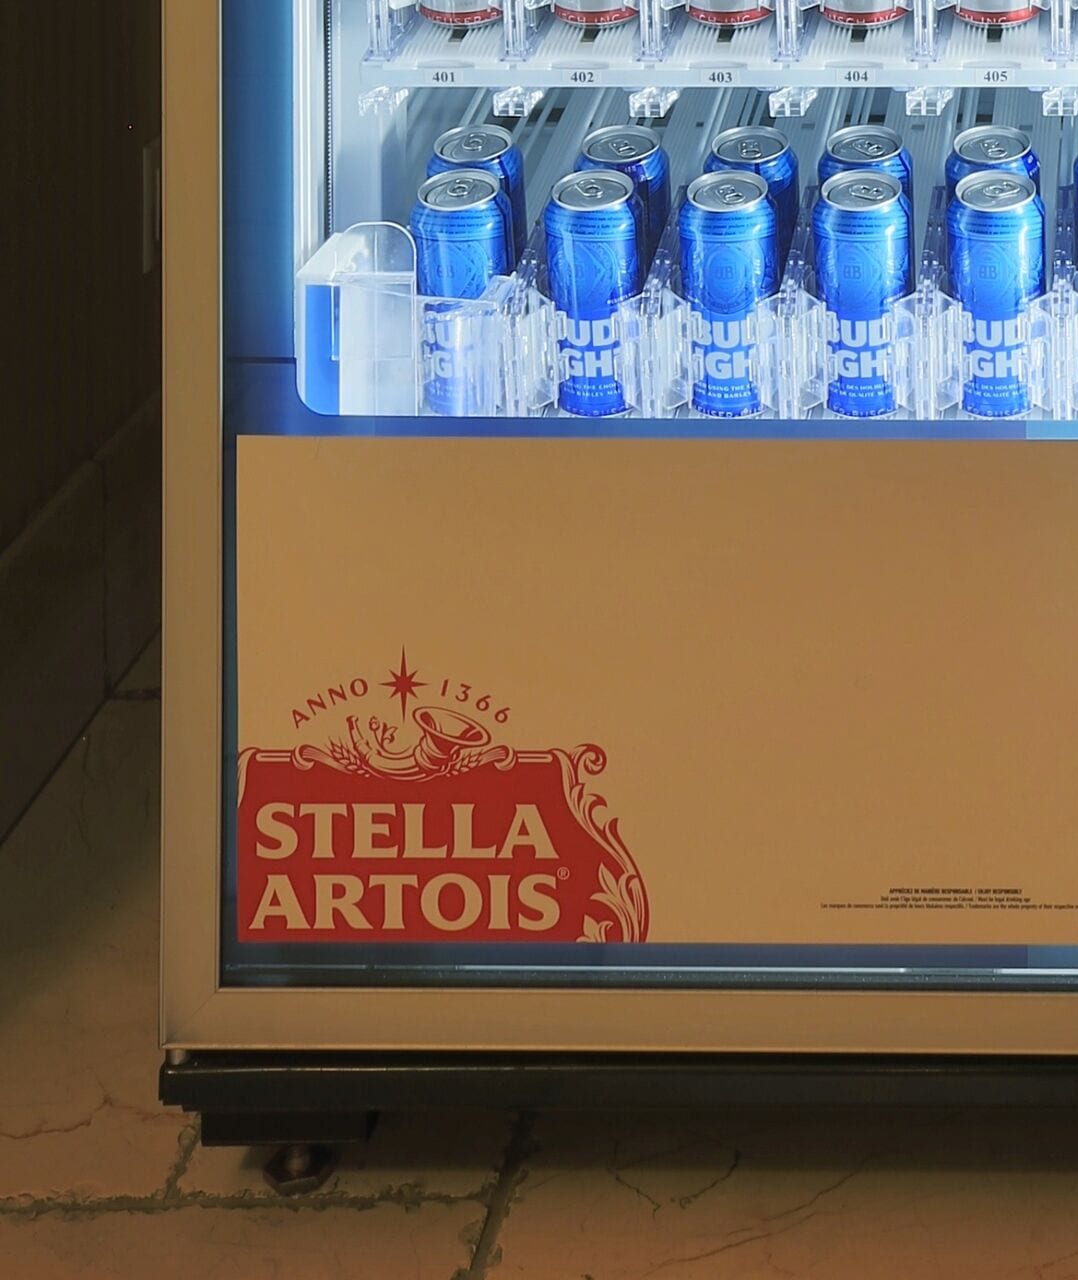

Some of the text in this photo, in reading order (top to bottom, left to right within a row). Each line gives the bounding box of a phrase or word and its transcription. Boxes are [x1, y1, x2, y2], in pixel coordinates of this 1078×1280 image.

[432, 71, 455, 83] 401
[570, 71, 594, 83] 402
[709, 72, 733, 83] 403
[844, 71, 868, 83] 404
[983, 70, 1008, 82] 405
[291, 678, 512, 729] ANNO 1366
[255, 802, 560, 860] STELLA
[248, 873, 562, 932] ARTOIS
